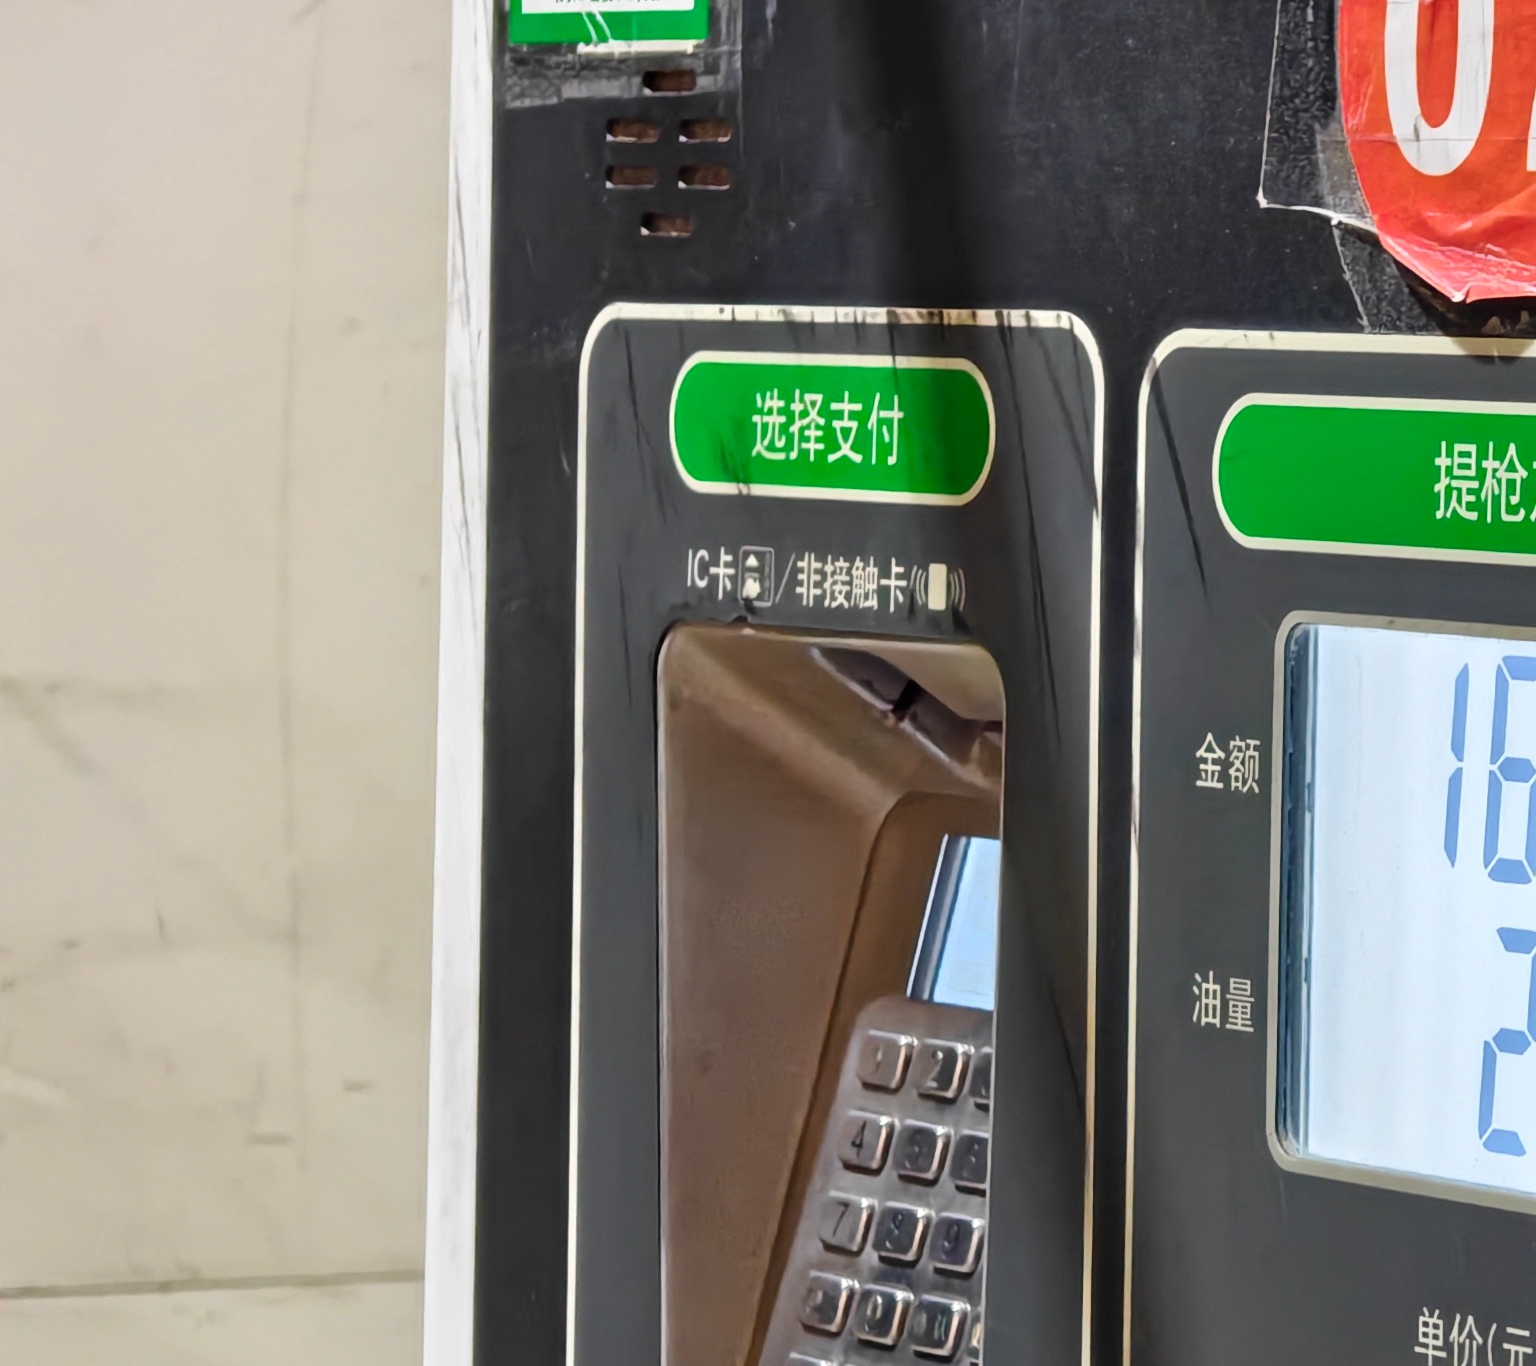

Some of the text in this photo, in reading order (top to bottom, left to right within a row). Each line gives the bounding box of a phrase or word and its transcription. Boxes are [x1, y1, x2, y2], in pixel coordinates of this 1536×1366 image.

[751, 387, 904, 466] 选择支付
[686, 545, 736, 601] IC卡
[1195, 732, 1261, 795] 金额
[1191, 970, 1256, 1034] 油量
